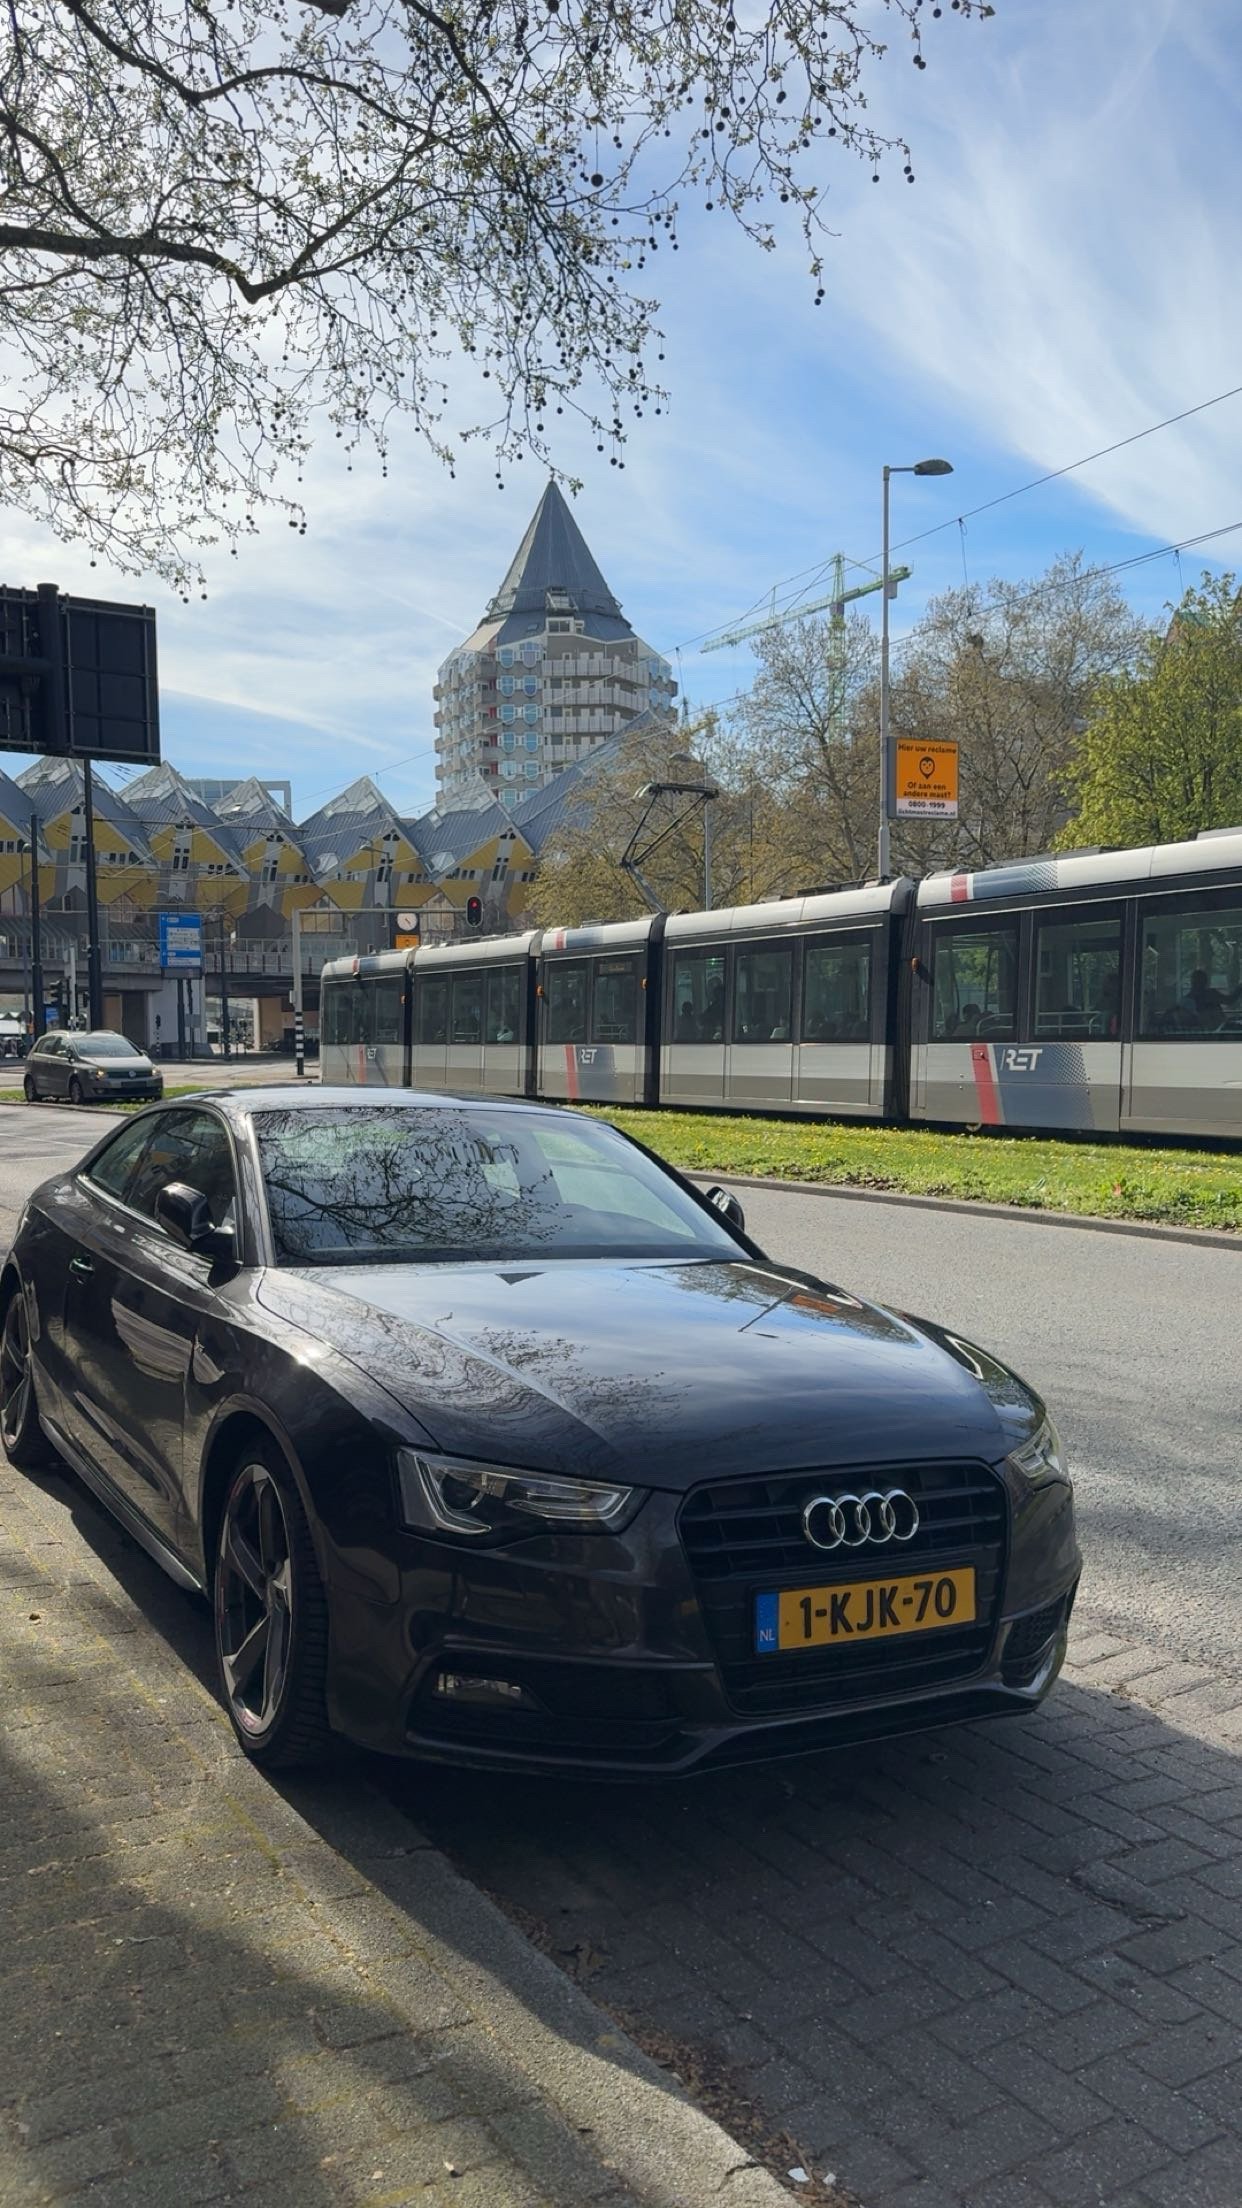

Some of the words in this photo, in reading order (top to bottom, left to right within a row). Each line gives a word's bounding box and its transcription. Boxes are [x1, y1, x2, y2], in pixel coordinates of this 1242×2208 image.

[581, 1049, 597, 1064] RET
[1005, 1049, 1043, 1070] RET
[799, 1576, 957, 1640] 1-KJK-70
[759, 1629, 776, 1642] NL
